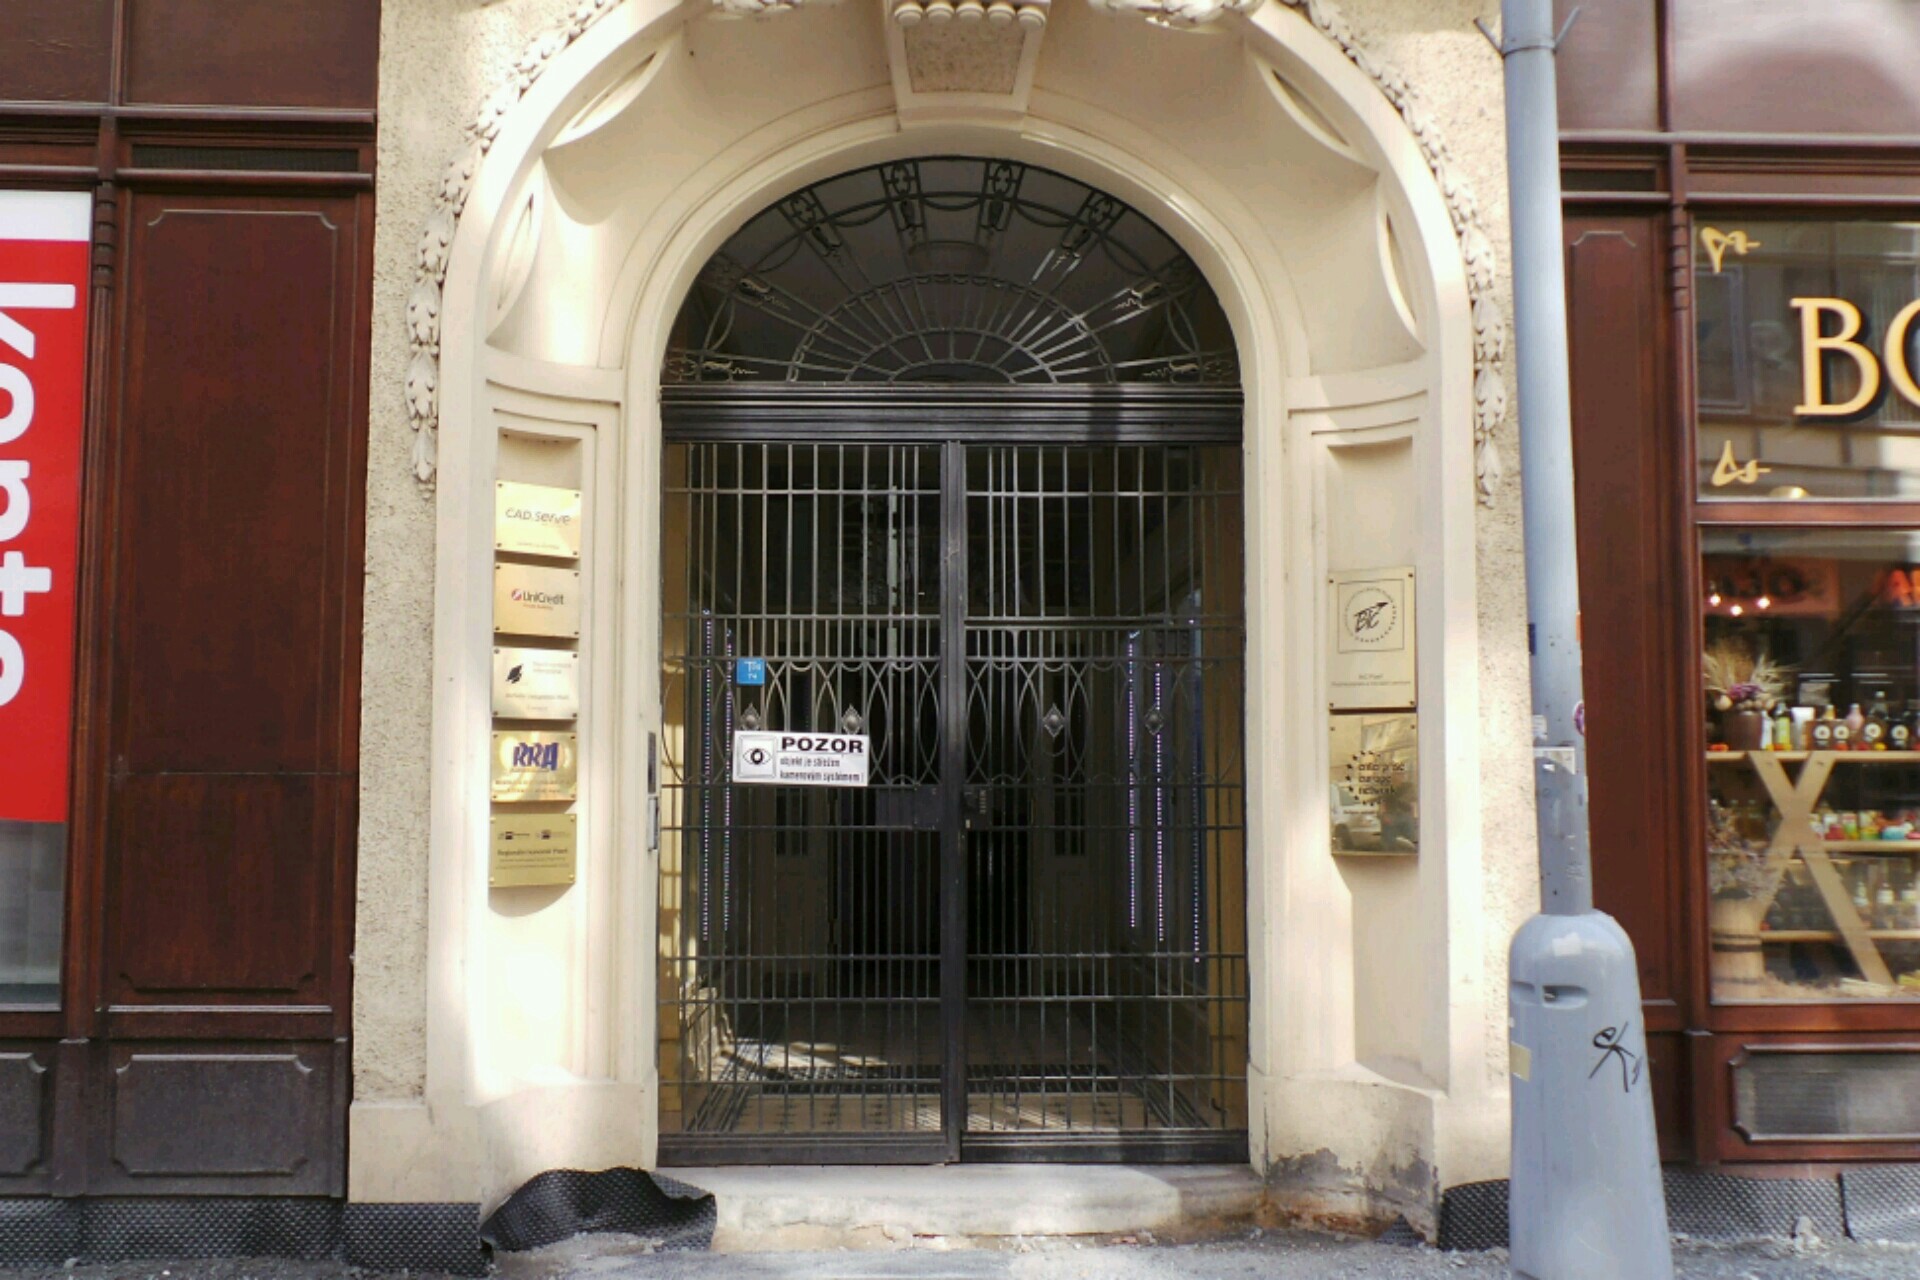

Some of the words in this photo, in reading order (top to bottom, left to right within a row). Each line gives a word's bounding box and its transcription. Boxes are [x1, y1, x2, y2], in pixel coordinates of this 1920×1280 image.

[523, 590, 564, 605] UniCredit
[782, 736, 864, 753] POZOR
[513, 742, 559, 771] RRA
